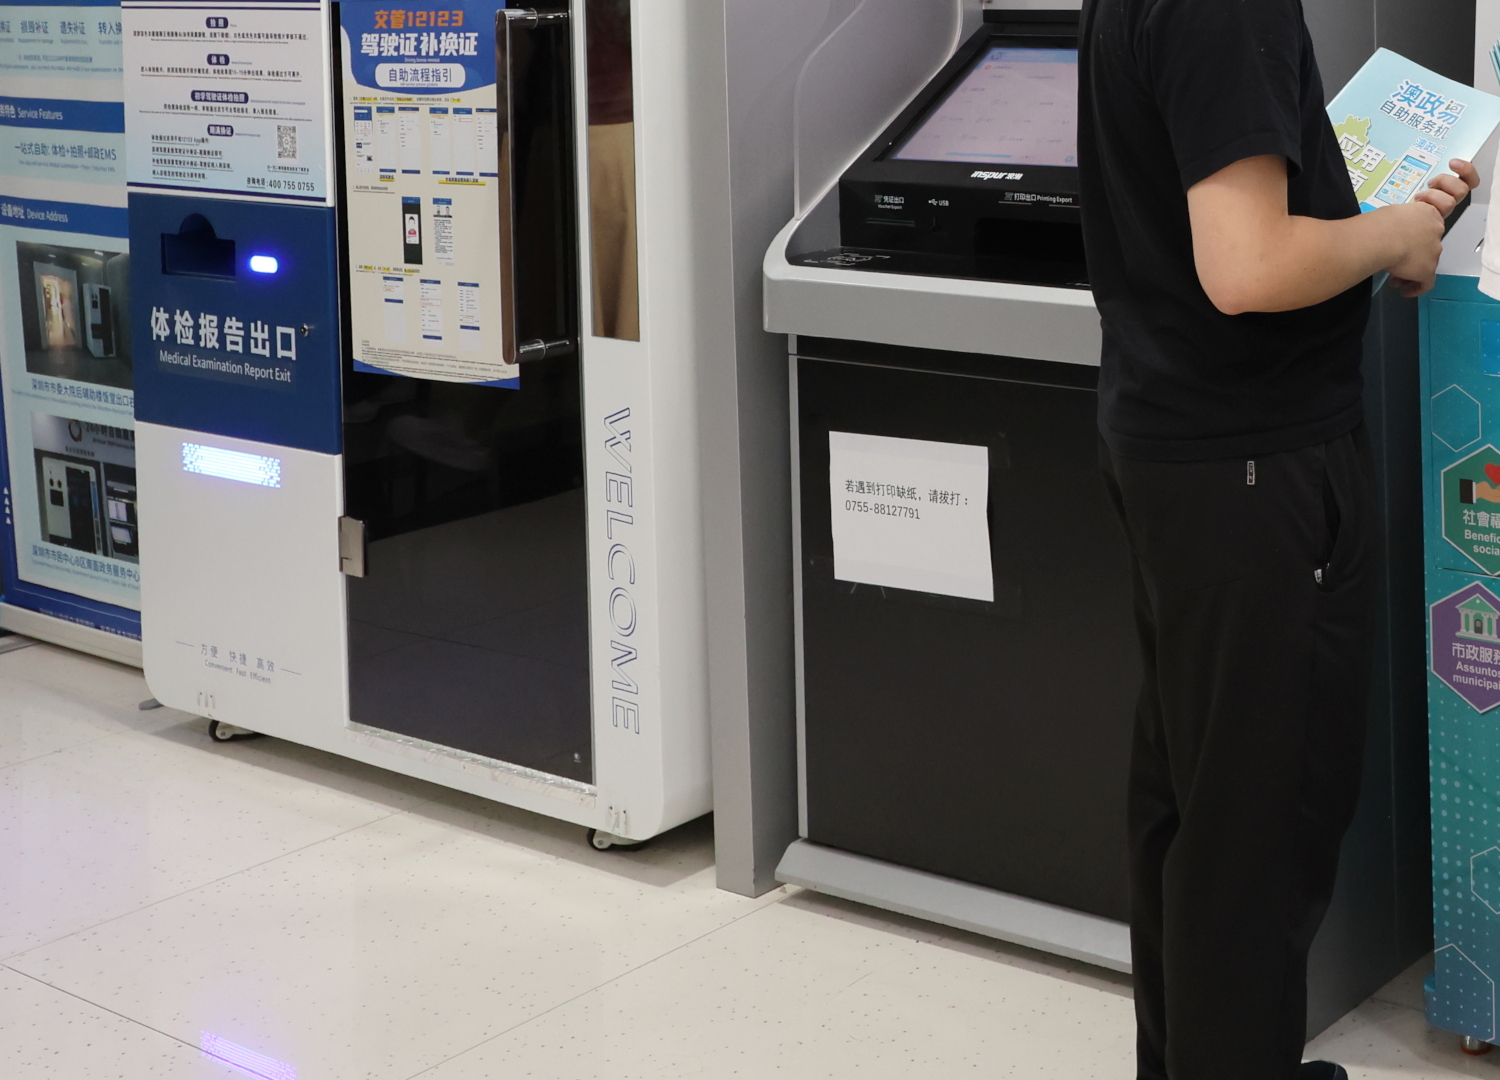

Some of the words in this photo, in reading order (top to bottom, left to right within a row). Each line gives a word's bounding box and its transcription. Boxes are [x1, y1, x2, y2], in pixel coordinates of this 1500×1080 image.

[374, 9, 464, 29] 交管12123
[361, 32, 479, 57] 驾驶证补换证
[389, 68, 452, 83] 自助流程指引
[18, 108, 38, 119] Service
[39, 108, 63, 120] Features
[1379, 100, 1451, 140] 自助服务机
[1338, 133, 1386, 172] 应用
[971, 170, 1007, 180] inspur
[283, 181, 296, 190] 755
[297, 181, 315, 192] 0755
[883, 195, 904, 204] 凭证出口
[938, 199, 949, 207] USB
[1014, 192, 1037, 202] 打印出口
[1037, 194, 1056, 204] Printing
[1057, 195, 1073, 204] Export
[27, 208, 45, 220] Device
[46, 210, 68, 222] Address
[151, 306, 297, 361] 体检报告出口
[160, 350, 191, 367] Medical
[192, 354, 242, 375] Examination
[244, 362, 273, 380] Report
[274, 366, 291, 382] Exit
[845, 500, 921, 520] 0755-88127791
[603, 407, 640, 735] WELCOME
[201, 643, 218, 659] 方便
[229, 650, 246, 666] 快捷
[257, 658, 274, 673] 高效
